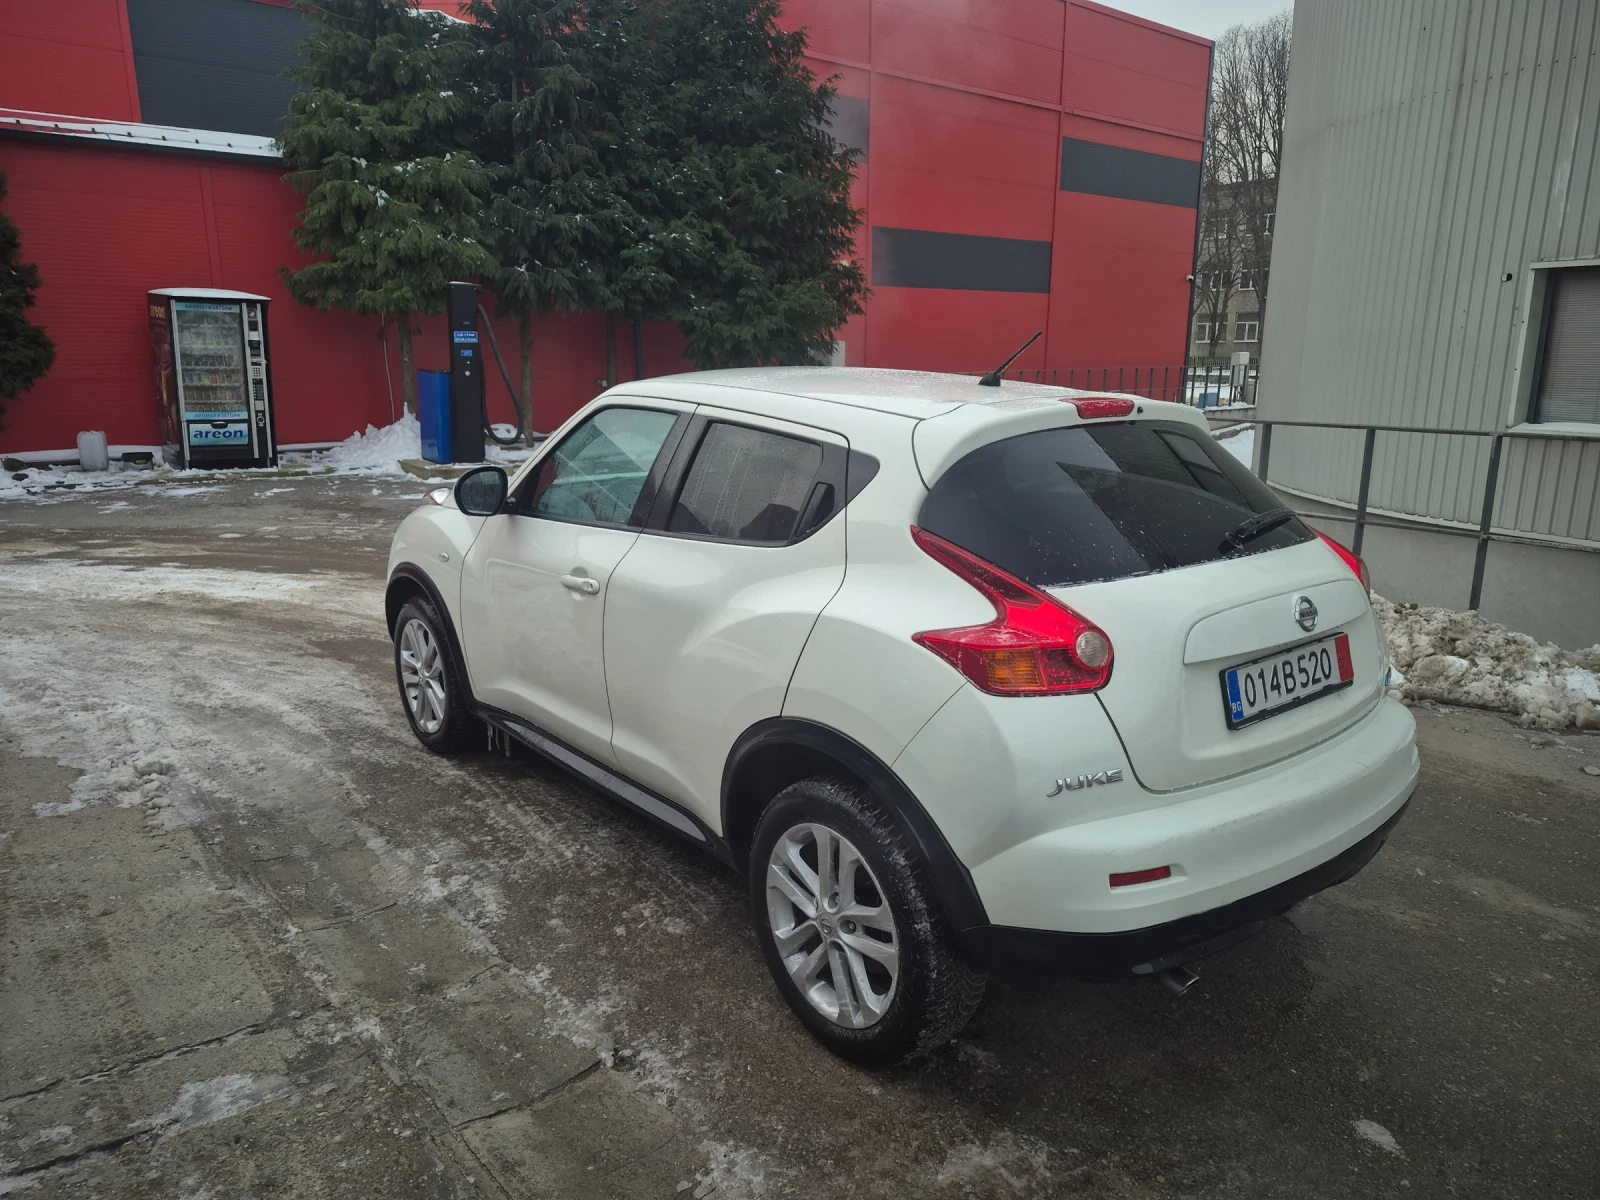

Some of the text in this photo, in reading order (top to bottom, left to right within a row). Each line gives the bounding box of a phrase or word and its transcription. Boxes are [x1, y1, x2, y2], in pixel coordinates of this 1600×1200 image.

[184, 303, 233, 311] АРОМАТИЗАТОРИ
[193, 429, 244, 439] areon
[1244, 647, 1332, 708] 014B520
[1231, 701, 1242, 713] BG
[1046, 768, 1124, 797] JUKE
